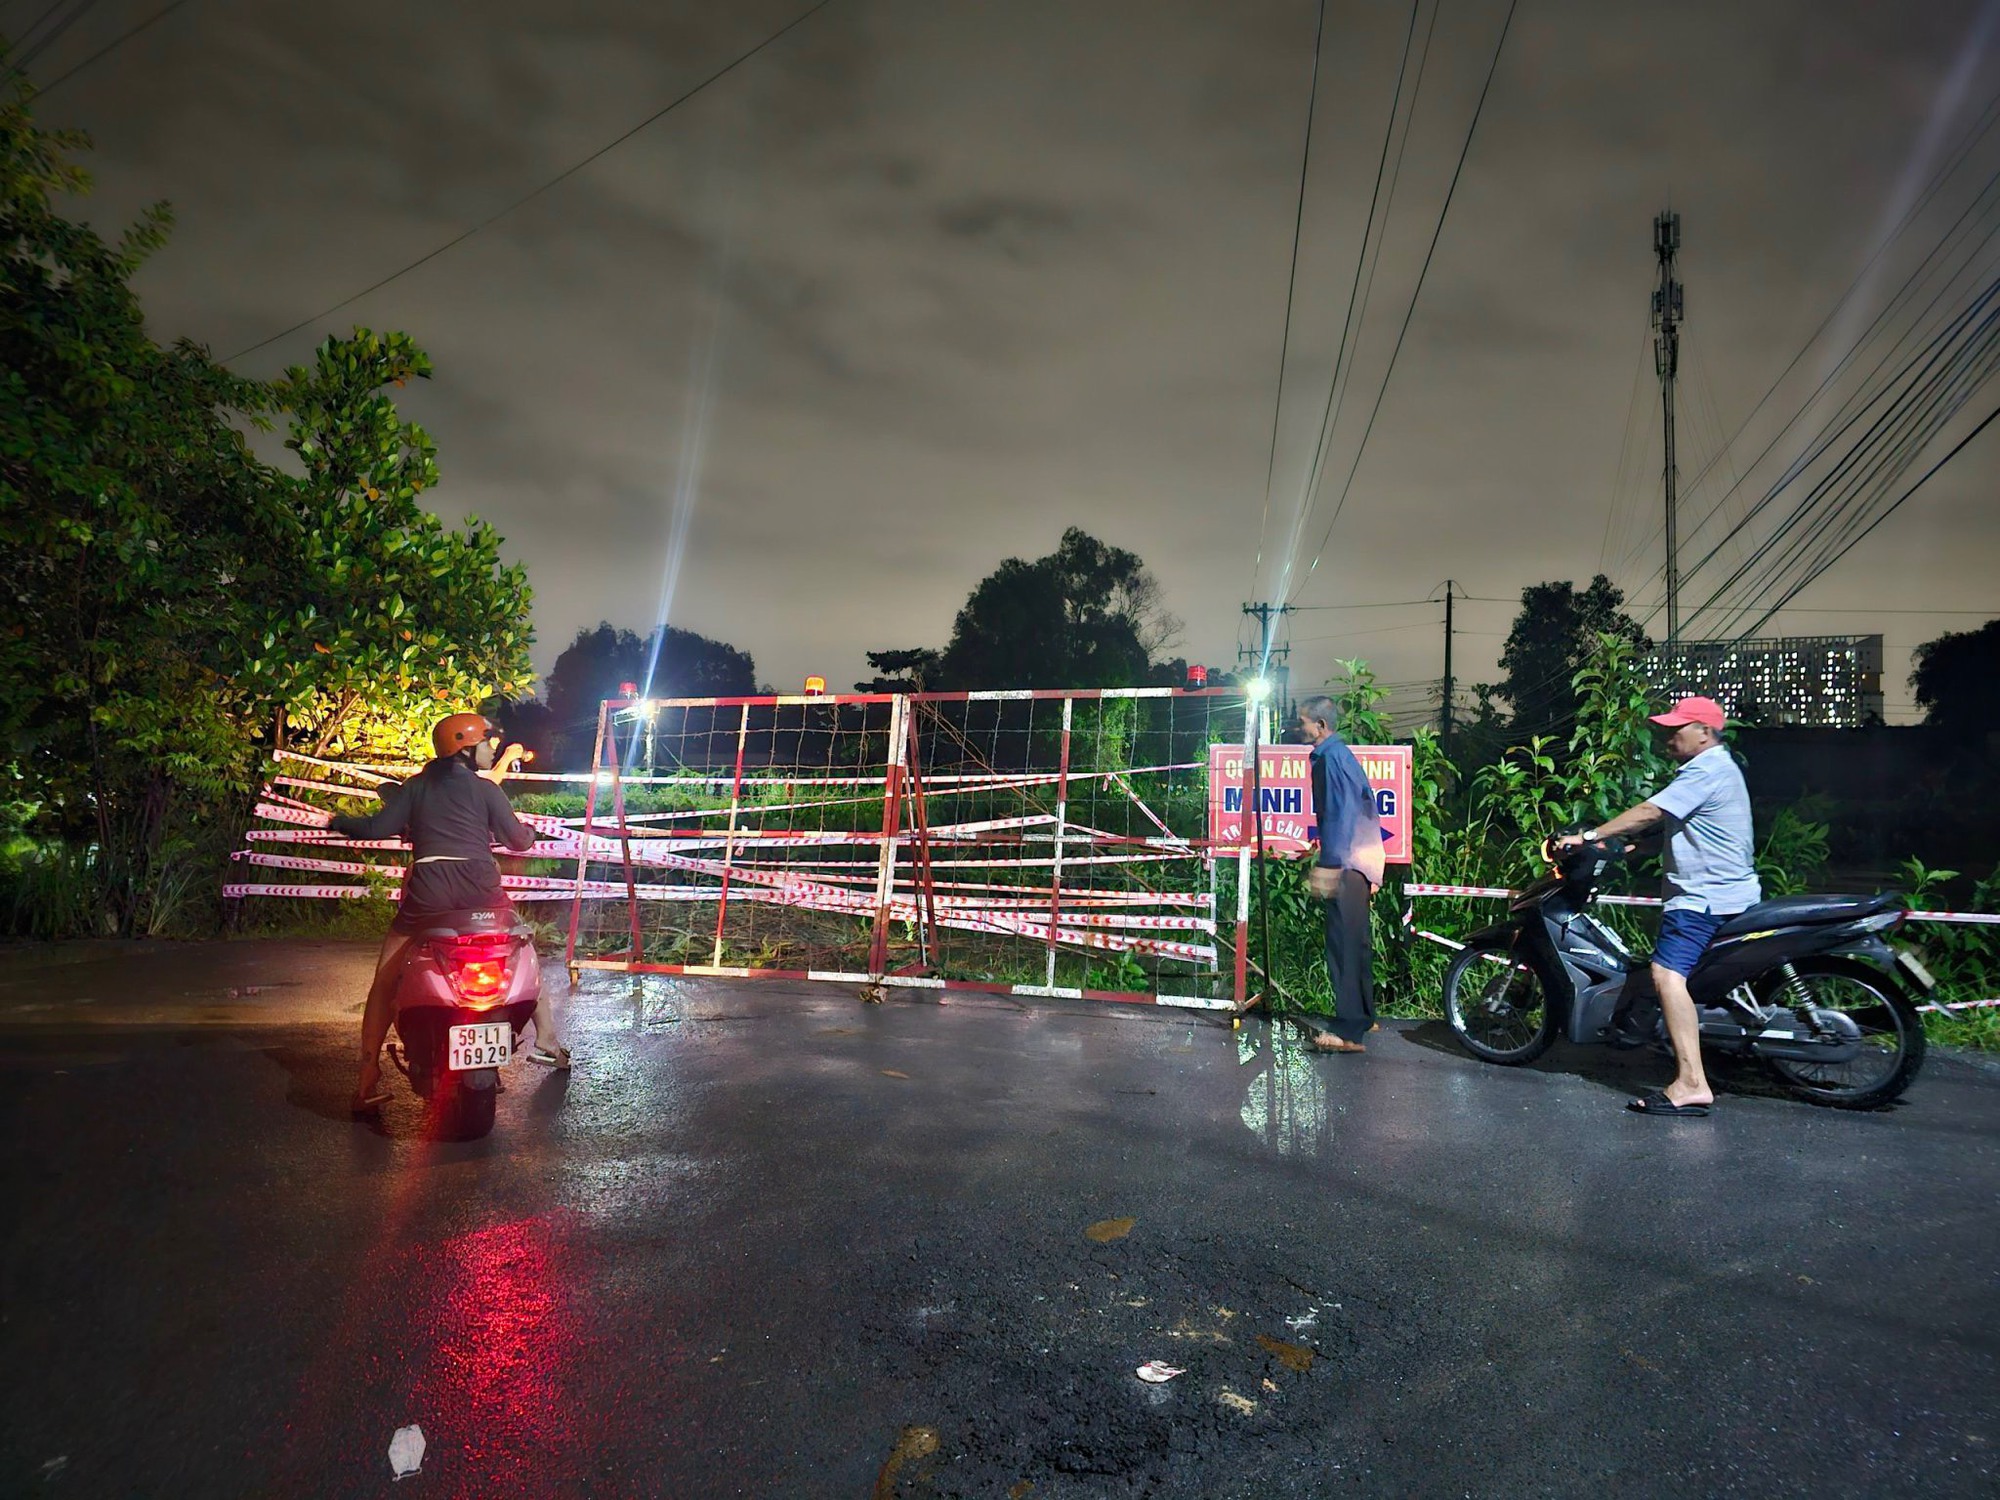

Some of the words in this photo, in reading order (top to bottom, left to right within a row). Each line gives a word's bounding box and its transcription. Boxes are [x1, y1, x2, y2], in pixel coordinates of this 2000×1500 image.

[1225, 759, 1275, 780] QUN
[1280, 756, 1306, 779] ĂN
[1361, 756, 1395, 780] ÌNH
[1224, 787, 1302, 814] MINH
[471, 911, 496, 920] SYM
[452, 1045, 507, 1067] 169.29
